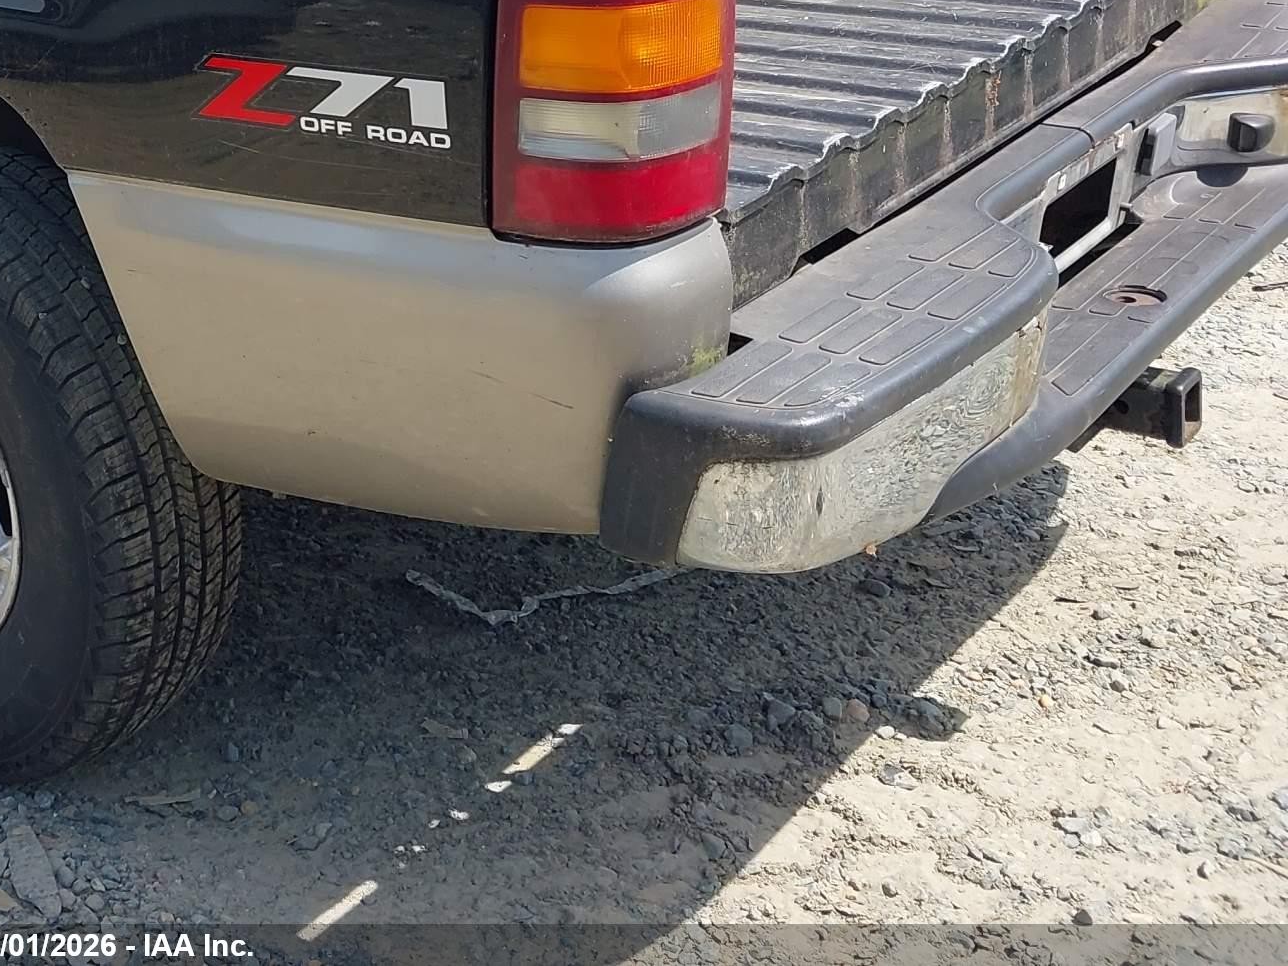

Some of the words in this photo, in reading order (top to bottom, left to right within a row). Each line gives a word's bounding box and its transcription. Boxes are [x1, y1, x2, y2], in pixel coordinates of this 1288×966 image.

[199, 57, 448, 131] Z71
[300, 116, 353, 136] OFF
[366, 125, 452, 150] ROAD
